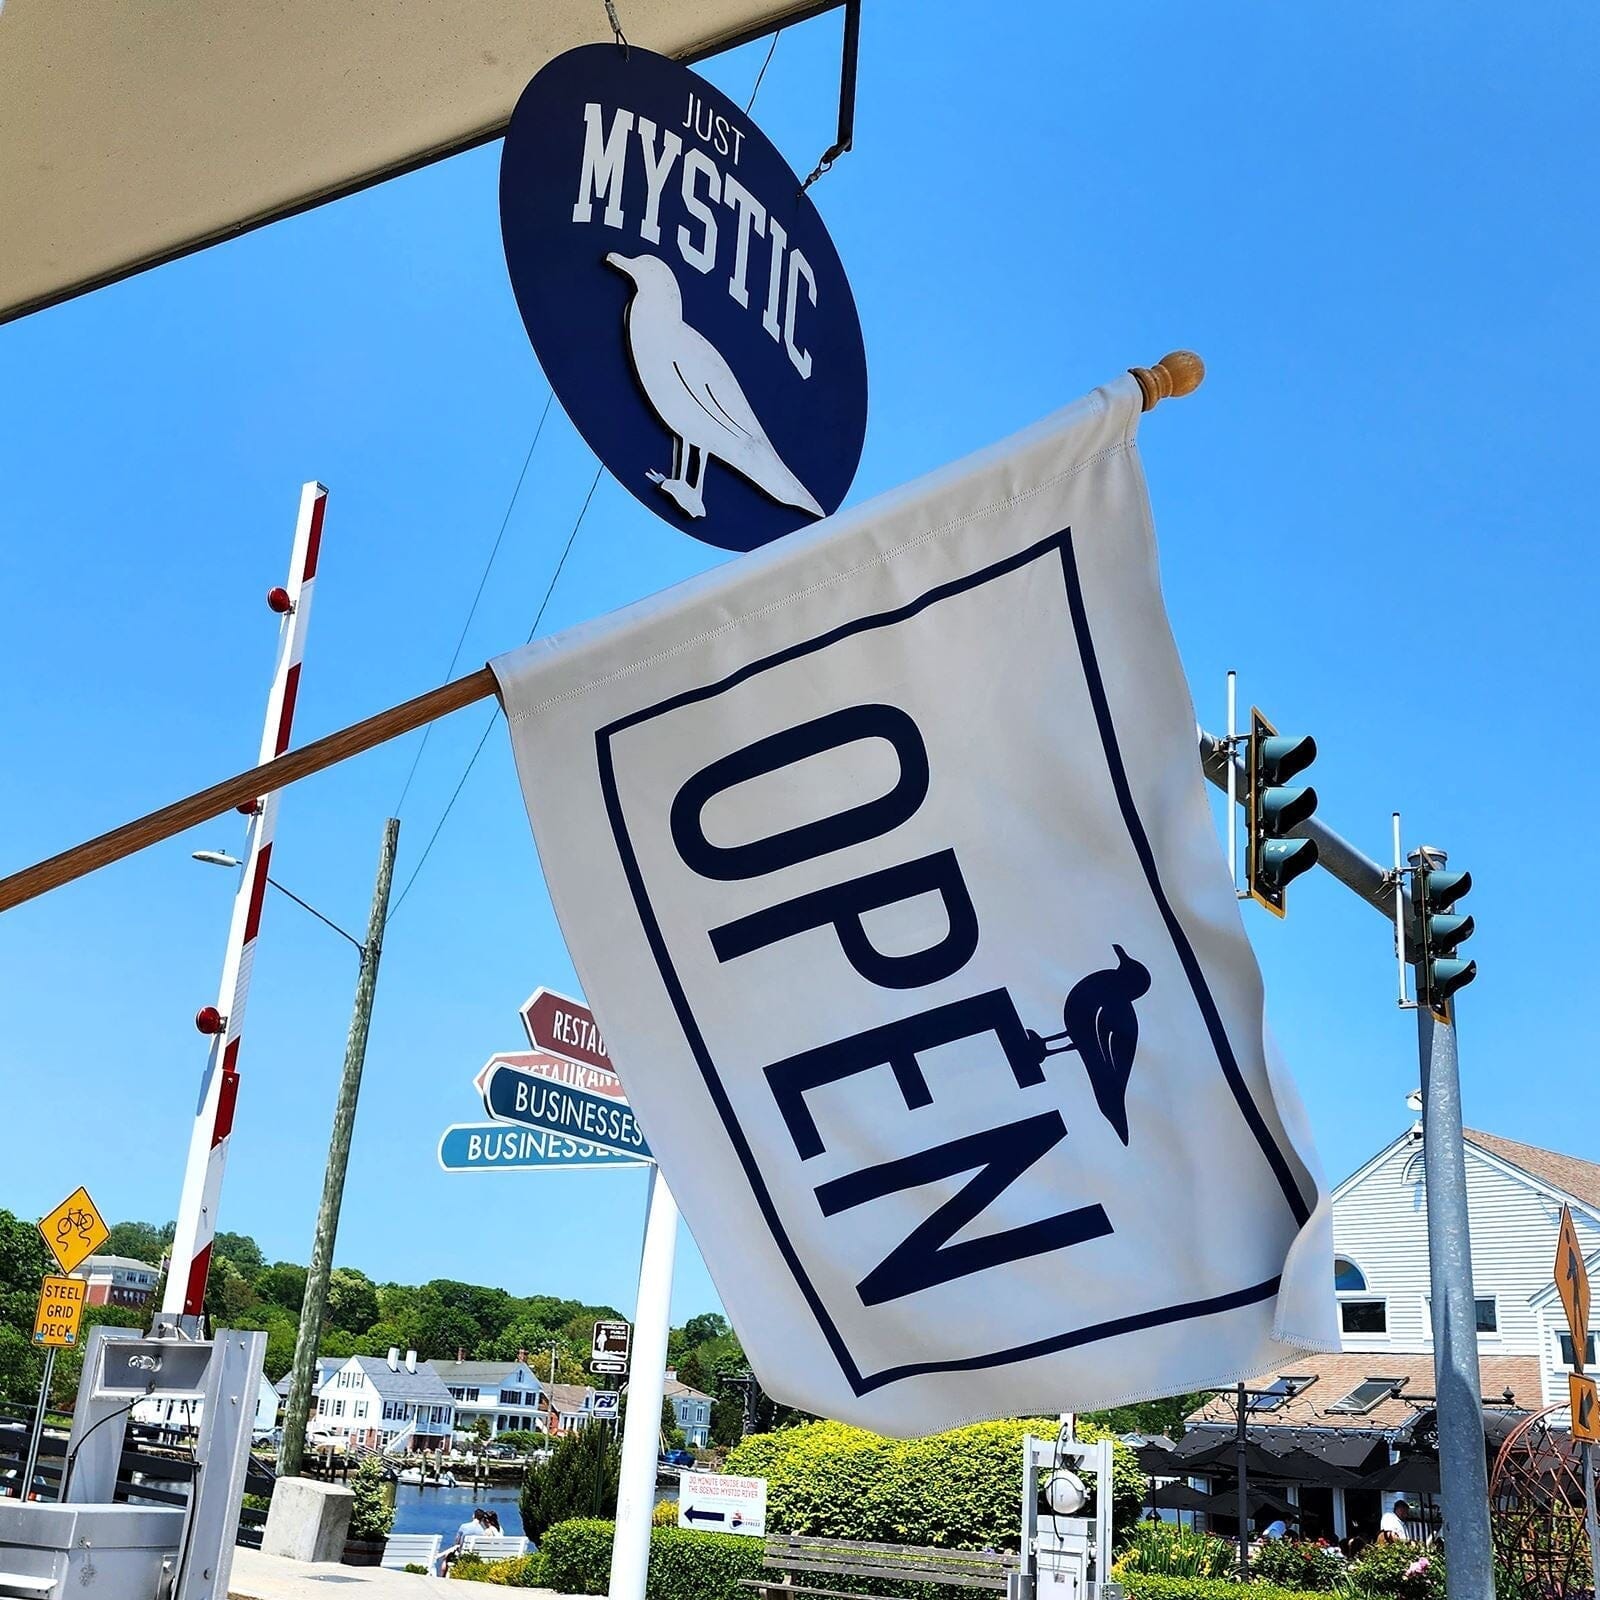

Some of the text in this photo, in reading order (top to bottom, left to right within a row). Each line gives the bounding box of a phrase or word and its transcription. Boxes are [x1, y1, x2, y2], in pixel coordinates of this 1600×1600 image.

[682, 92, 746, 166] JUST
[572, 102, 818, 380] MYSTIC
[670, 703, 1115, 1308] OPEN
[552, 1010, 609, 1058] RESTAU
[515, 1081, 644, 1146] BUSINESSES
[45, 1285, 81, 1300] STEEL
[47, 1304, 74, 1319] GRID
[41, 1323, 72, 1337] DECK
[689, 1485, 698, 1493] THE
[720, 1488, 741, 1497] MYSTIC
[741, 1489, 758, 1498] RIVER
[698, 1477, 718, 1486] MINUTE
[719, 1478, 739, 1488] CRUISE
[740, 1480, 758, 1489] ALONG
